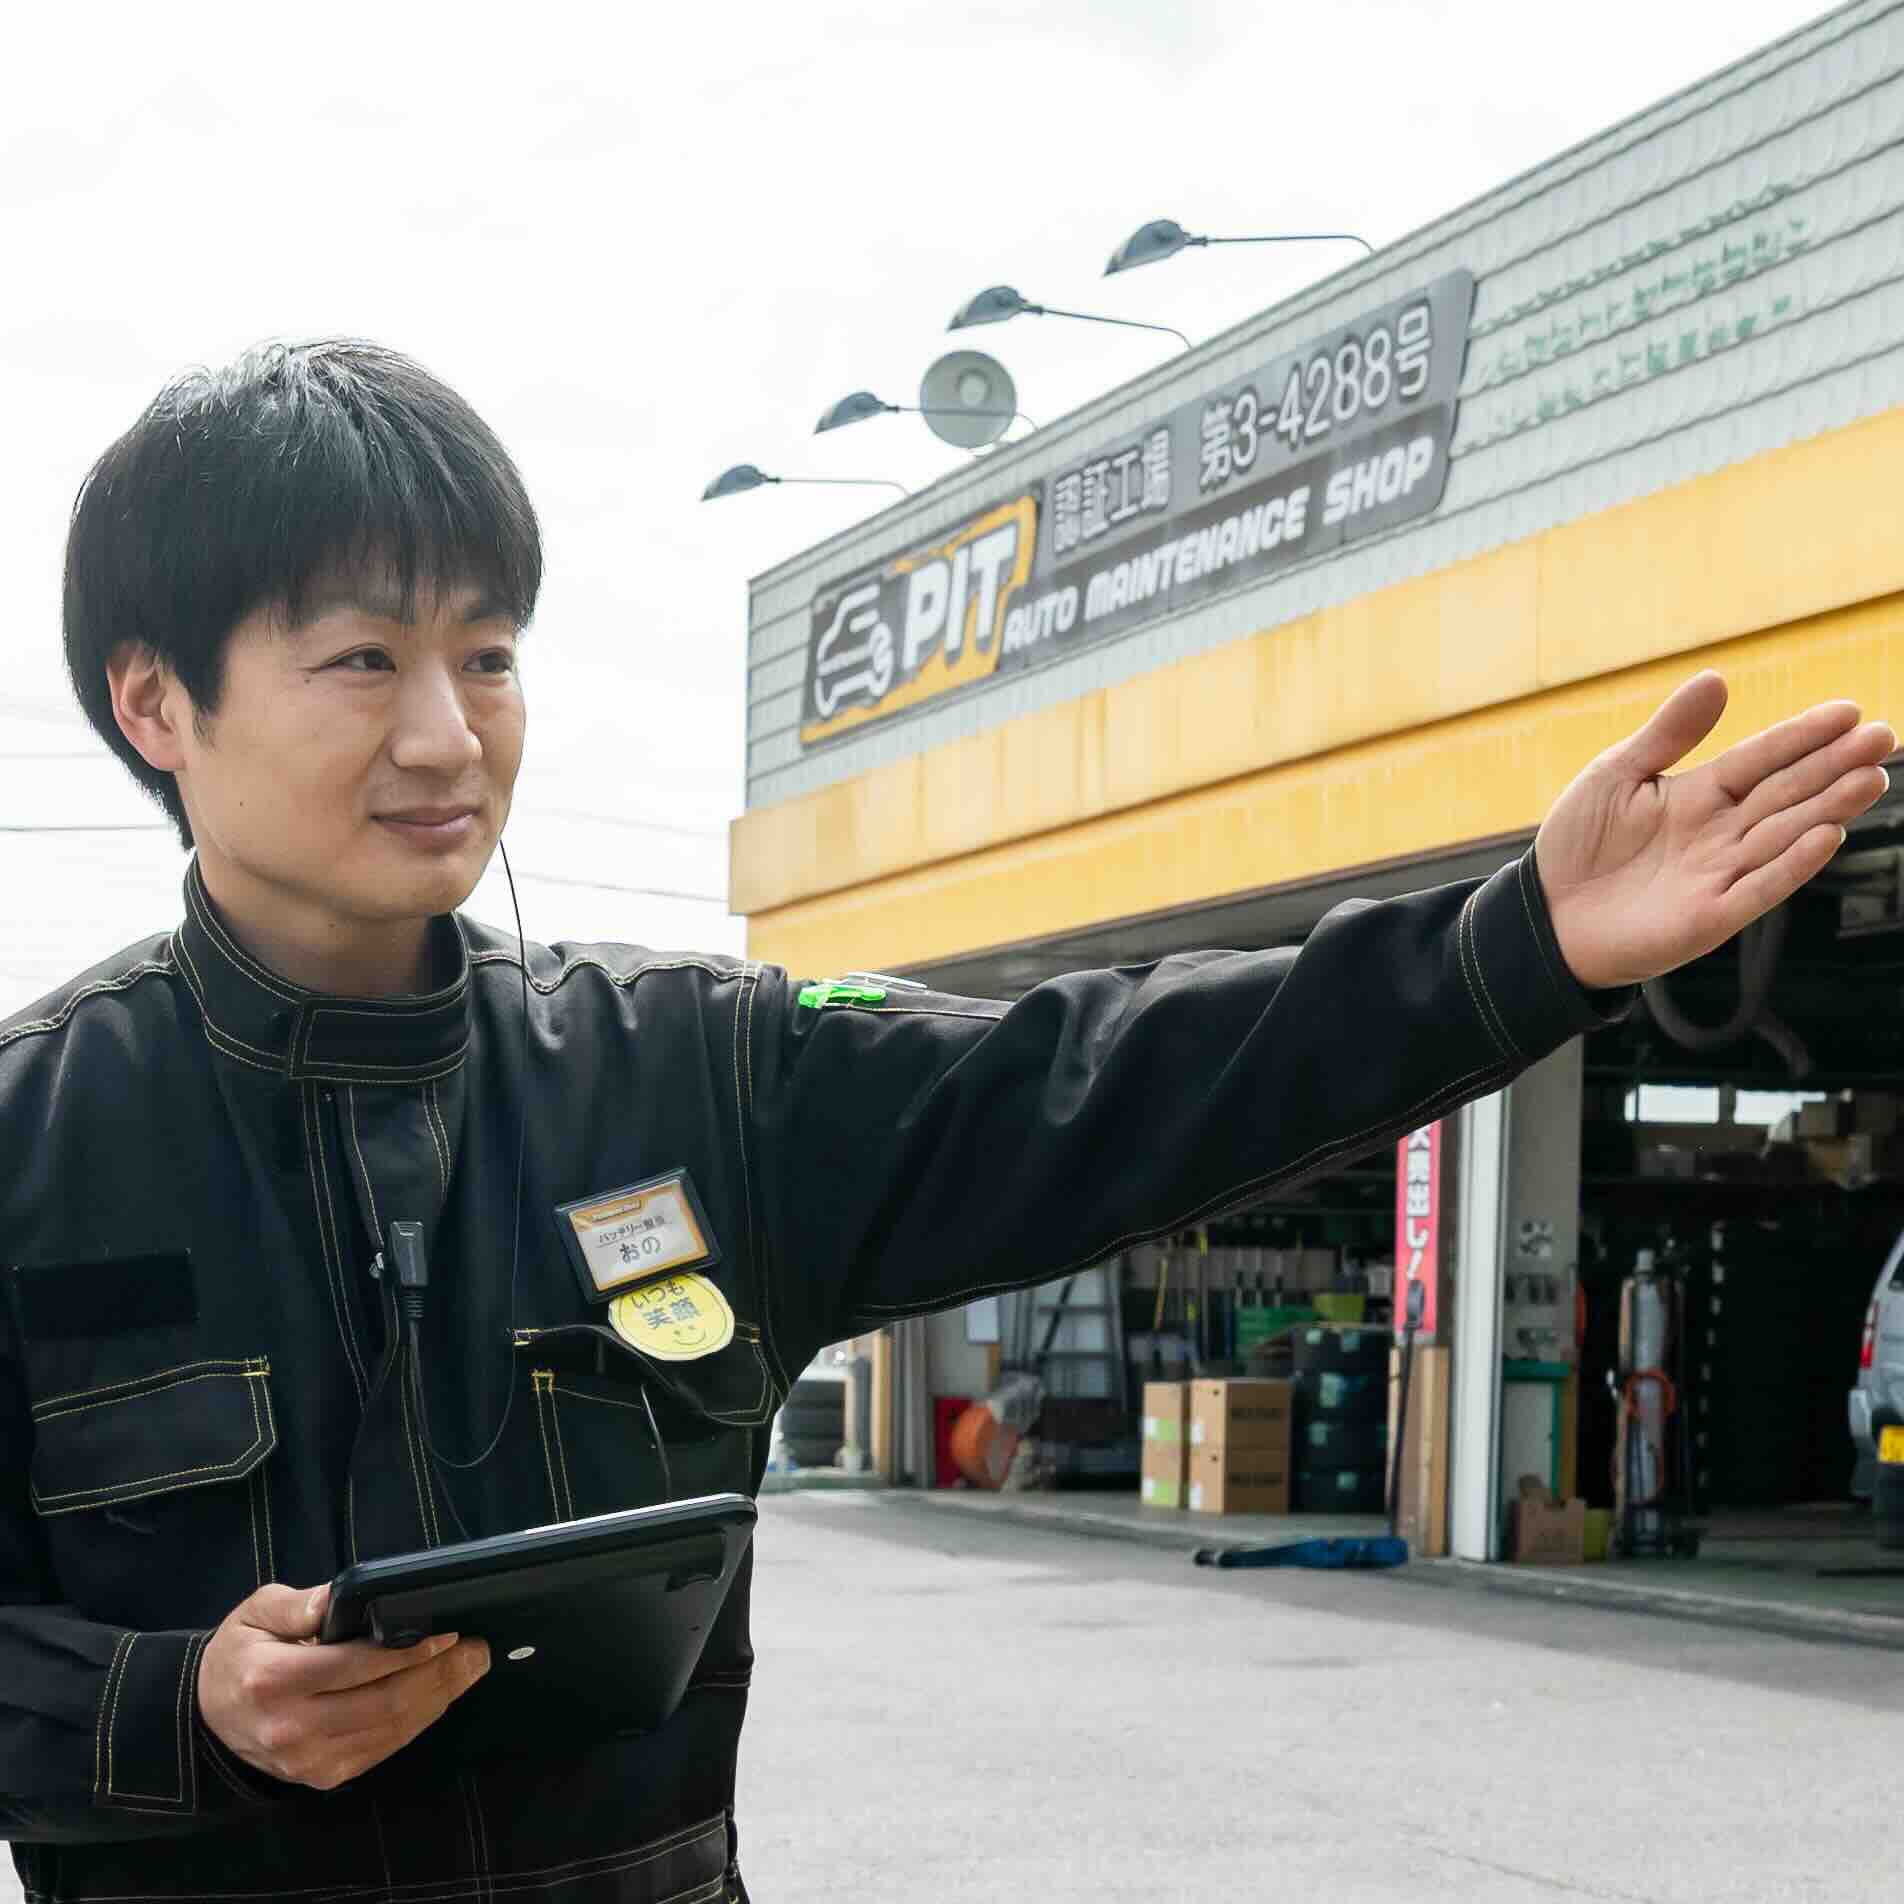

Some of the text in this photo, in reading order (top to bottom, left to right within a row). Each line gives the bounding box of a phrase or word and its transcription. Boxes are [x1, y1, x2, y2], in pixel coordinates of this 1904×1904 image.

[1051, 428, 1171, 553] 認証工場
[1200, 303, 1430, 489] 第3-4288号
[900, 515, 1021, 670] PIT
[1002, 434, 1434, 656] AUTO MAINTENANCE SHOP
[630, 1279, 685, 1310] いつも
[641, 1296, 703, 1331] 笑顔
